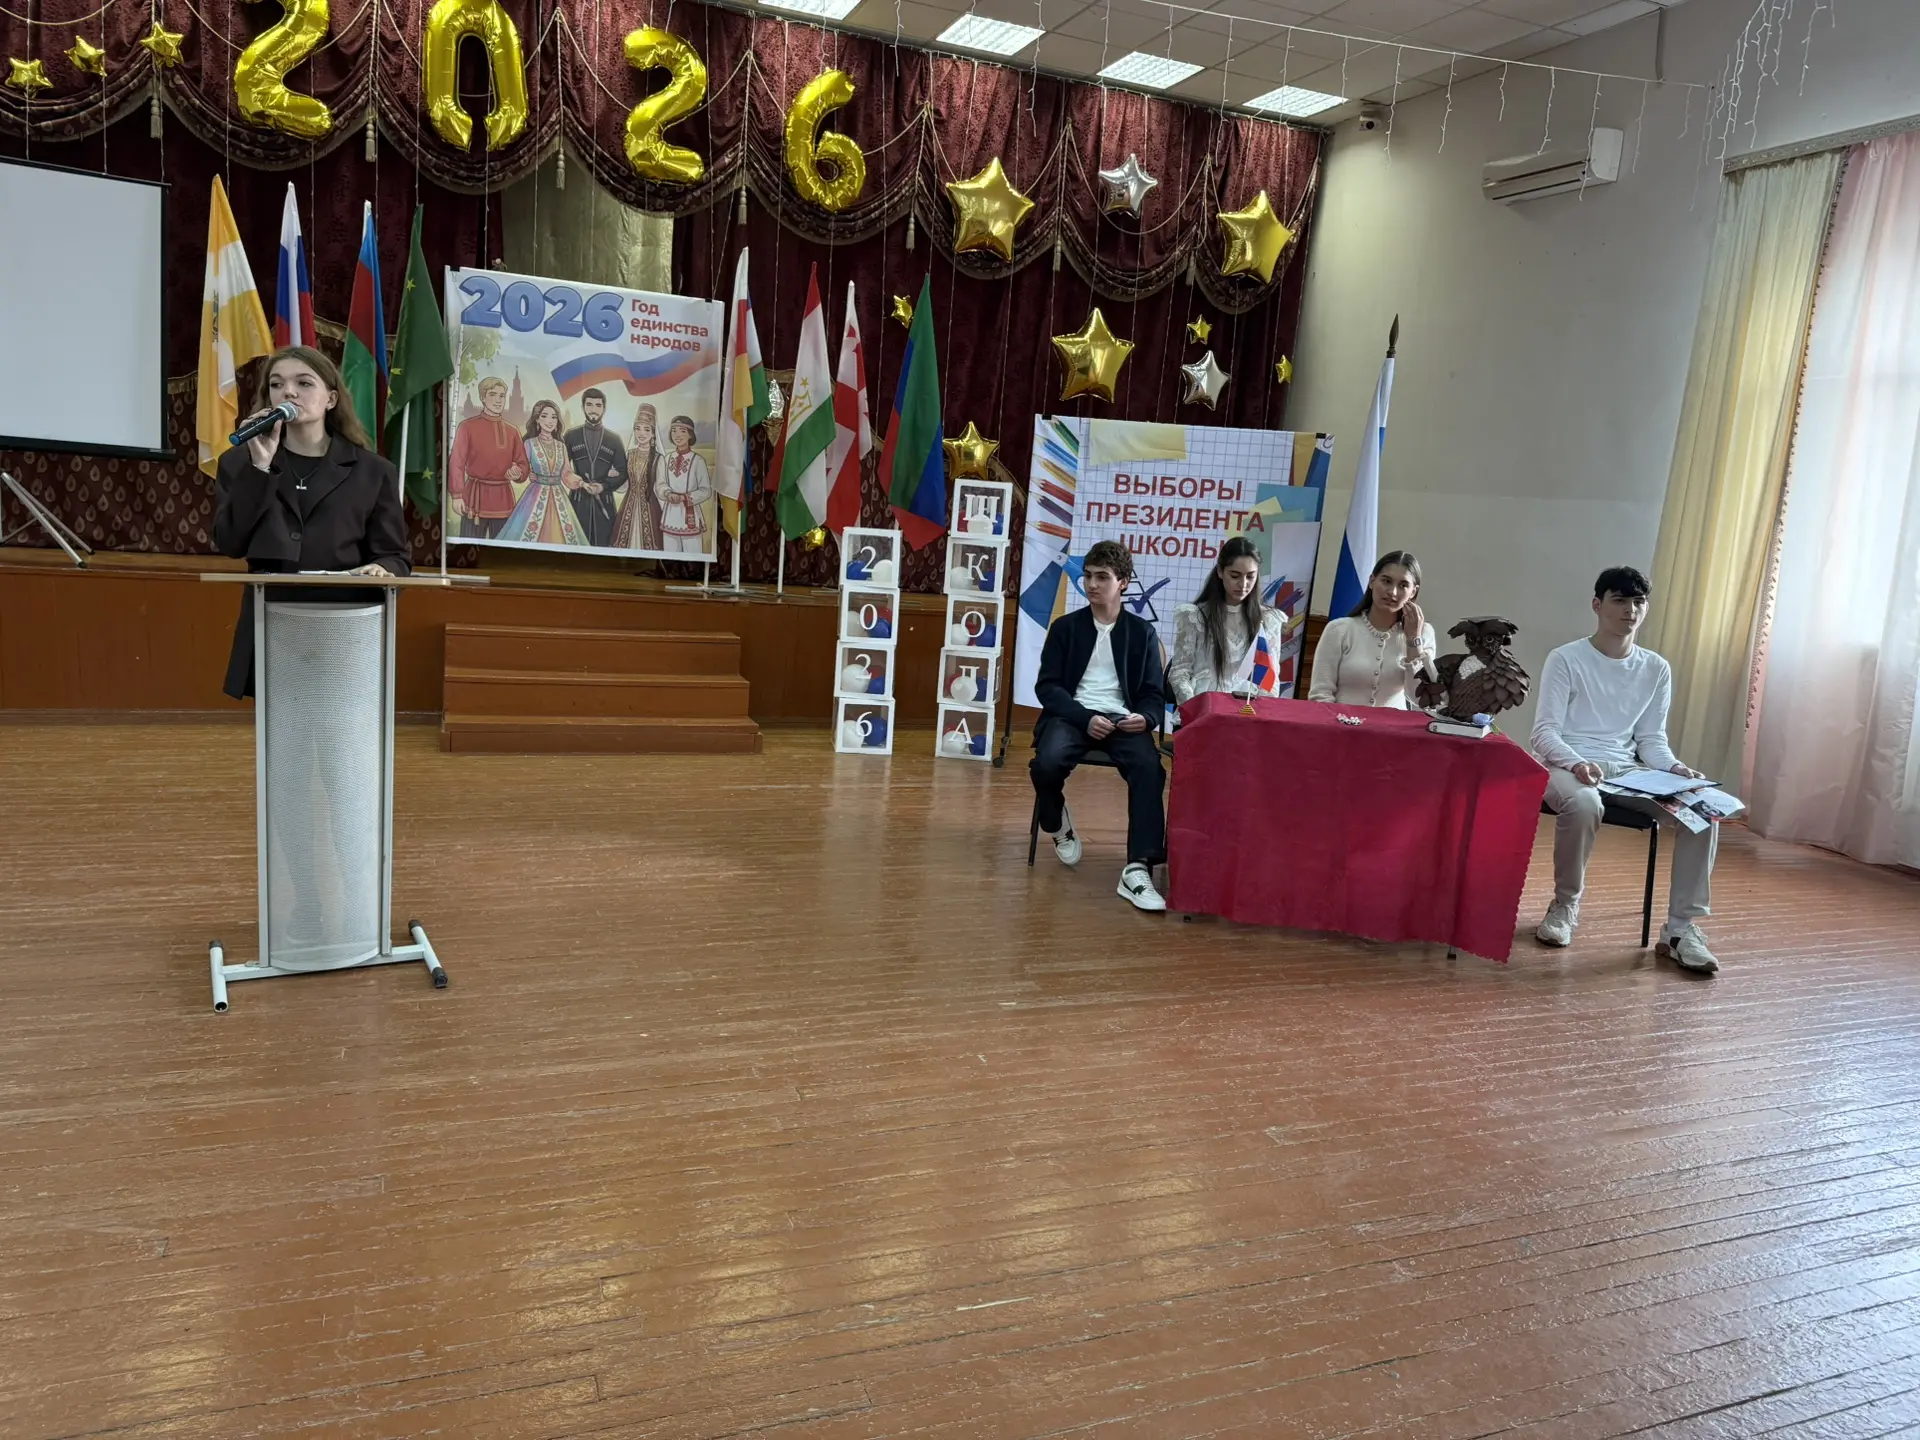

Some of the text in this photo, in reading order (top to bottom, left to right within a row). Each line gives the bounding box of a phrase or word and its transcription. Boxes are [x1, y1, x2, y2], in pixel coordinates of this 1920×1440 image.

[234, 0, 866, 211] 2026
[459, 275, 624, 342] 2026
[632, 299, 659, 316] Год
[630, 318, 709, 337] единства
[630, 333, 701, 352] народов
[1113, 473, 1242, 501] ВЫБОРЫ
[1086, 501, 1265, 532] ПРЕЗИДЕНТА
